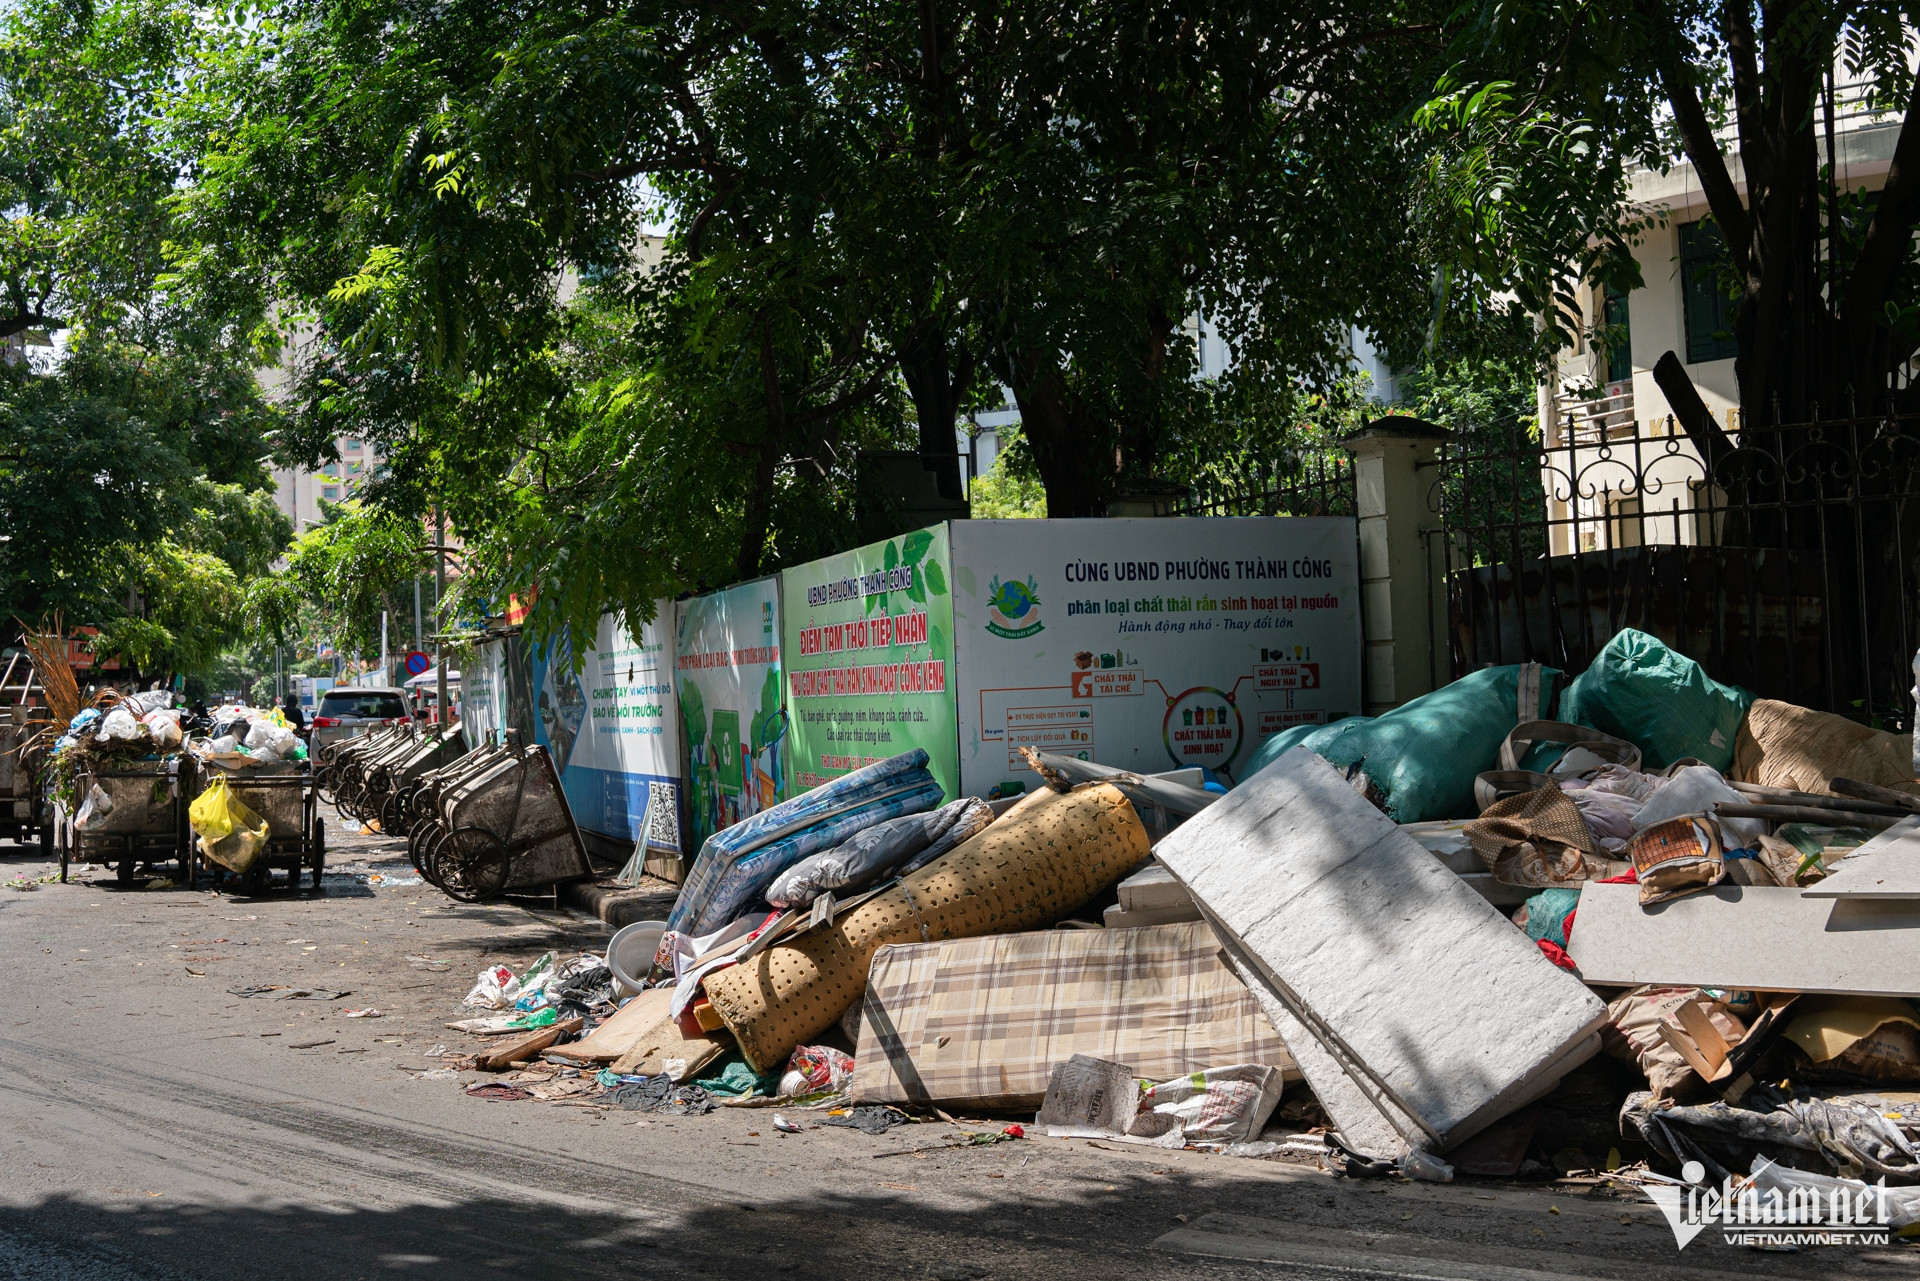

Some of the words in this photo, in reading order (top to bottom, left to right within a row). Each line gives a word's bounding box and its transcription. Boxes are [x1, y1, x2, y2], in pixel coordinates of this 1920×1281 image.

[1065, 558, 1109, 582] CÙNG
[1115, 562, 1159, 581] UBND
[1165, 557, 1230, 580] PHƯỜNG
[1235, 556, 1287, 579] THÀNH
[1292, 556, 1332, 578] CÔNG
[808, 584, 826, 606] UBND
[828, 576, 858, 603] PHƯỜNG
[860, 569, 887, 597] THÀNH
[888, 564, 912, 591] CÔNG
[1068, 599, 1100, 616] phân
[1105, 599, 1129, 616] loại
[1134, 595, 1163, 613] chất
[1167, 595, 1192, 612] thải
[1196, 594, 1217, 611] rắn
[1221, 597, 1247, 611] sinh
[1251, 596, 1279, 613] hoạt
[1281, 595, 1297, 612] tại
[1301, 593, 1338, 610] nguồn
[800, 617, 822, 656] ĐIỂM
[823, 623, 843, 659] TẠM
[845, 615, 868, 650] THỜI
[870, 607, 892, 648] TIẾP
[894, 606, 927, 651] NHẬN
[1118, 620, 1151, 633] Hành
[1155, 620, 1185, 634] động
[1189, 619, 1212, 631] nhỏ
[1223, 618, 1250, 631] Thay
[1253, 616, 1272, 629] đổi
[1275, 617, 1293, 629] lớn
[802, 670, 816, 697] GOM
[817, 659, 831, 696] CHẤT
[832, 659, 846, 696] THẢI
[847, 656, 861, 696] RẮN
[862, 665, 877, 695] SINH
[877, 662, 898, 701] HOẠT
[900, 652, 921, 694] CỒNG
[922, 649, 945, 692] KỀNH
[1094, 672, 1116, 683] CHẤT
[1117, 671, 1136, 682] THẢI
[1259, 667, 1278, 677] CHẤT
[1280, 666, 1297, 676] THẢI
[593, 687, 613, 699] CHUNG
[615, 687, 628, 698] TAY
[637, 684, 648, 697] MỘT
[661, 683, 671, 694] ĐÔ
[1100, 684, 1113, 693] TÁI
[1115, 682, 1131, 693] CHẾ
[1261, 679, 1281, 687] NGUY
[1283, 678, 1296, 687] HẠI
[593, 704, 606, 718] BẢO
[607, 704, 616, 720] VỆ
[617, 703, 630, 718] MÔI
[632, 702, 663, 717] TRƯỜNG
[869, 708, 884, 725] khung
[899, 708, 911, 722] cánh
[1174, 727, 1194, 741] CHẤT
[1196, 727, 1213, 740] THẢI
[1216, 726, 1232, 739] RẮN
[1183, 744, 1202, 755] SINH
[1204, 743, 1224, 756] HOẠT
[1090, 1089, 1103, 1113] STEAK
